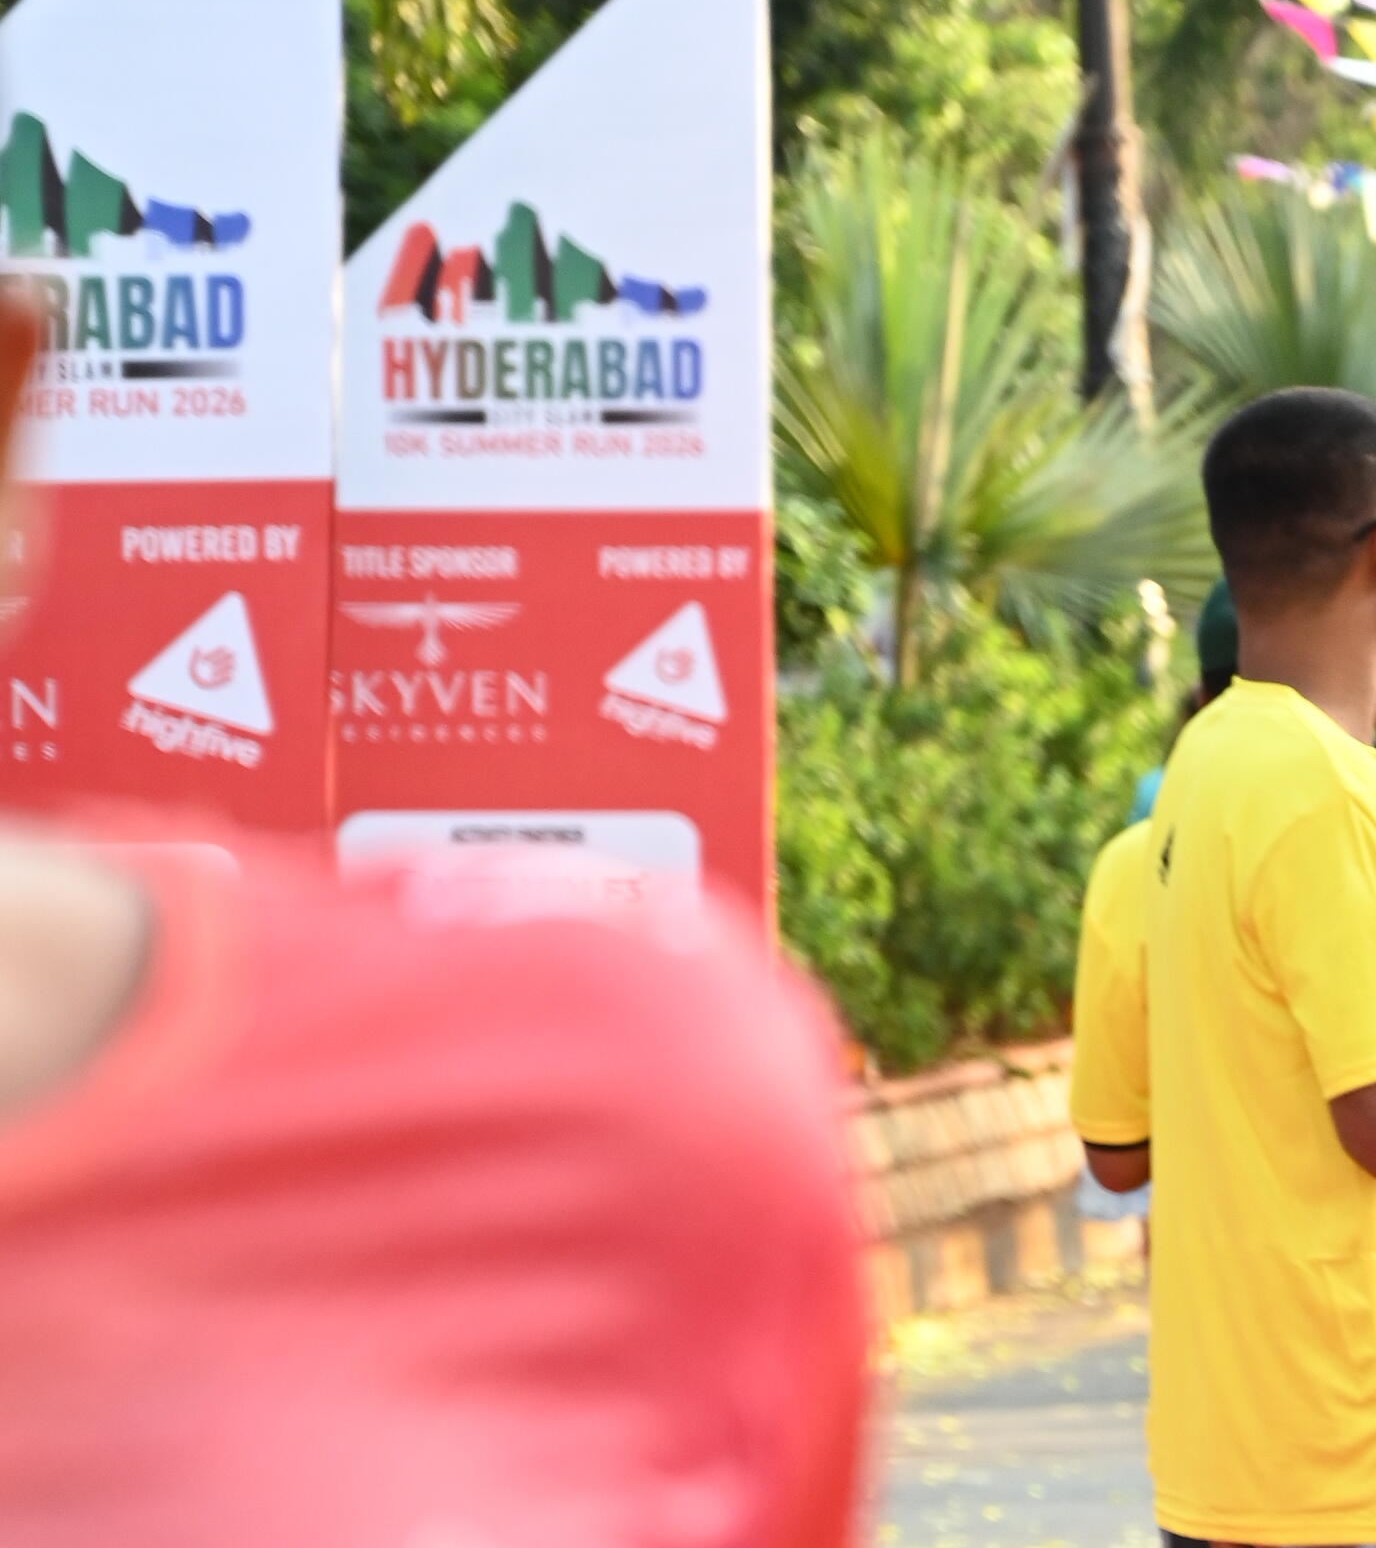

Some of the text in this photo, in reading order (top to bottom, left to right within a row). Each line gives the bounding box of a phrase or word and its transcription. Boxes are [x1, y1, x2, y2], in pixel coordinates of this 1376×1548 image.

[382, 338, 703, 400] HYDERABAD
[89, 388, 159, 419] RUN
[170, 387, 248, 417] 2026
[120, 523, 300, 564] POWERED BY
[598, 544, 751, 582] POWERED BY
